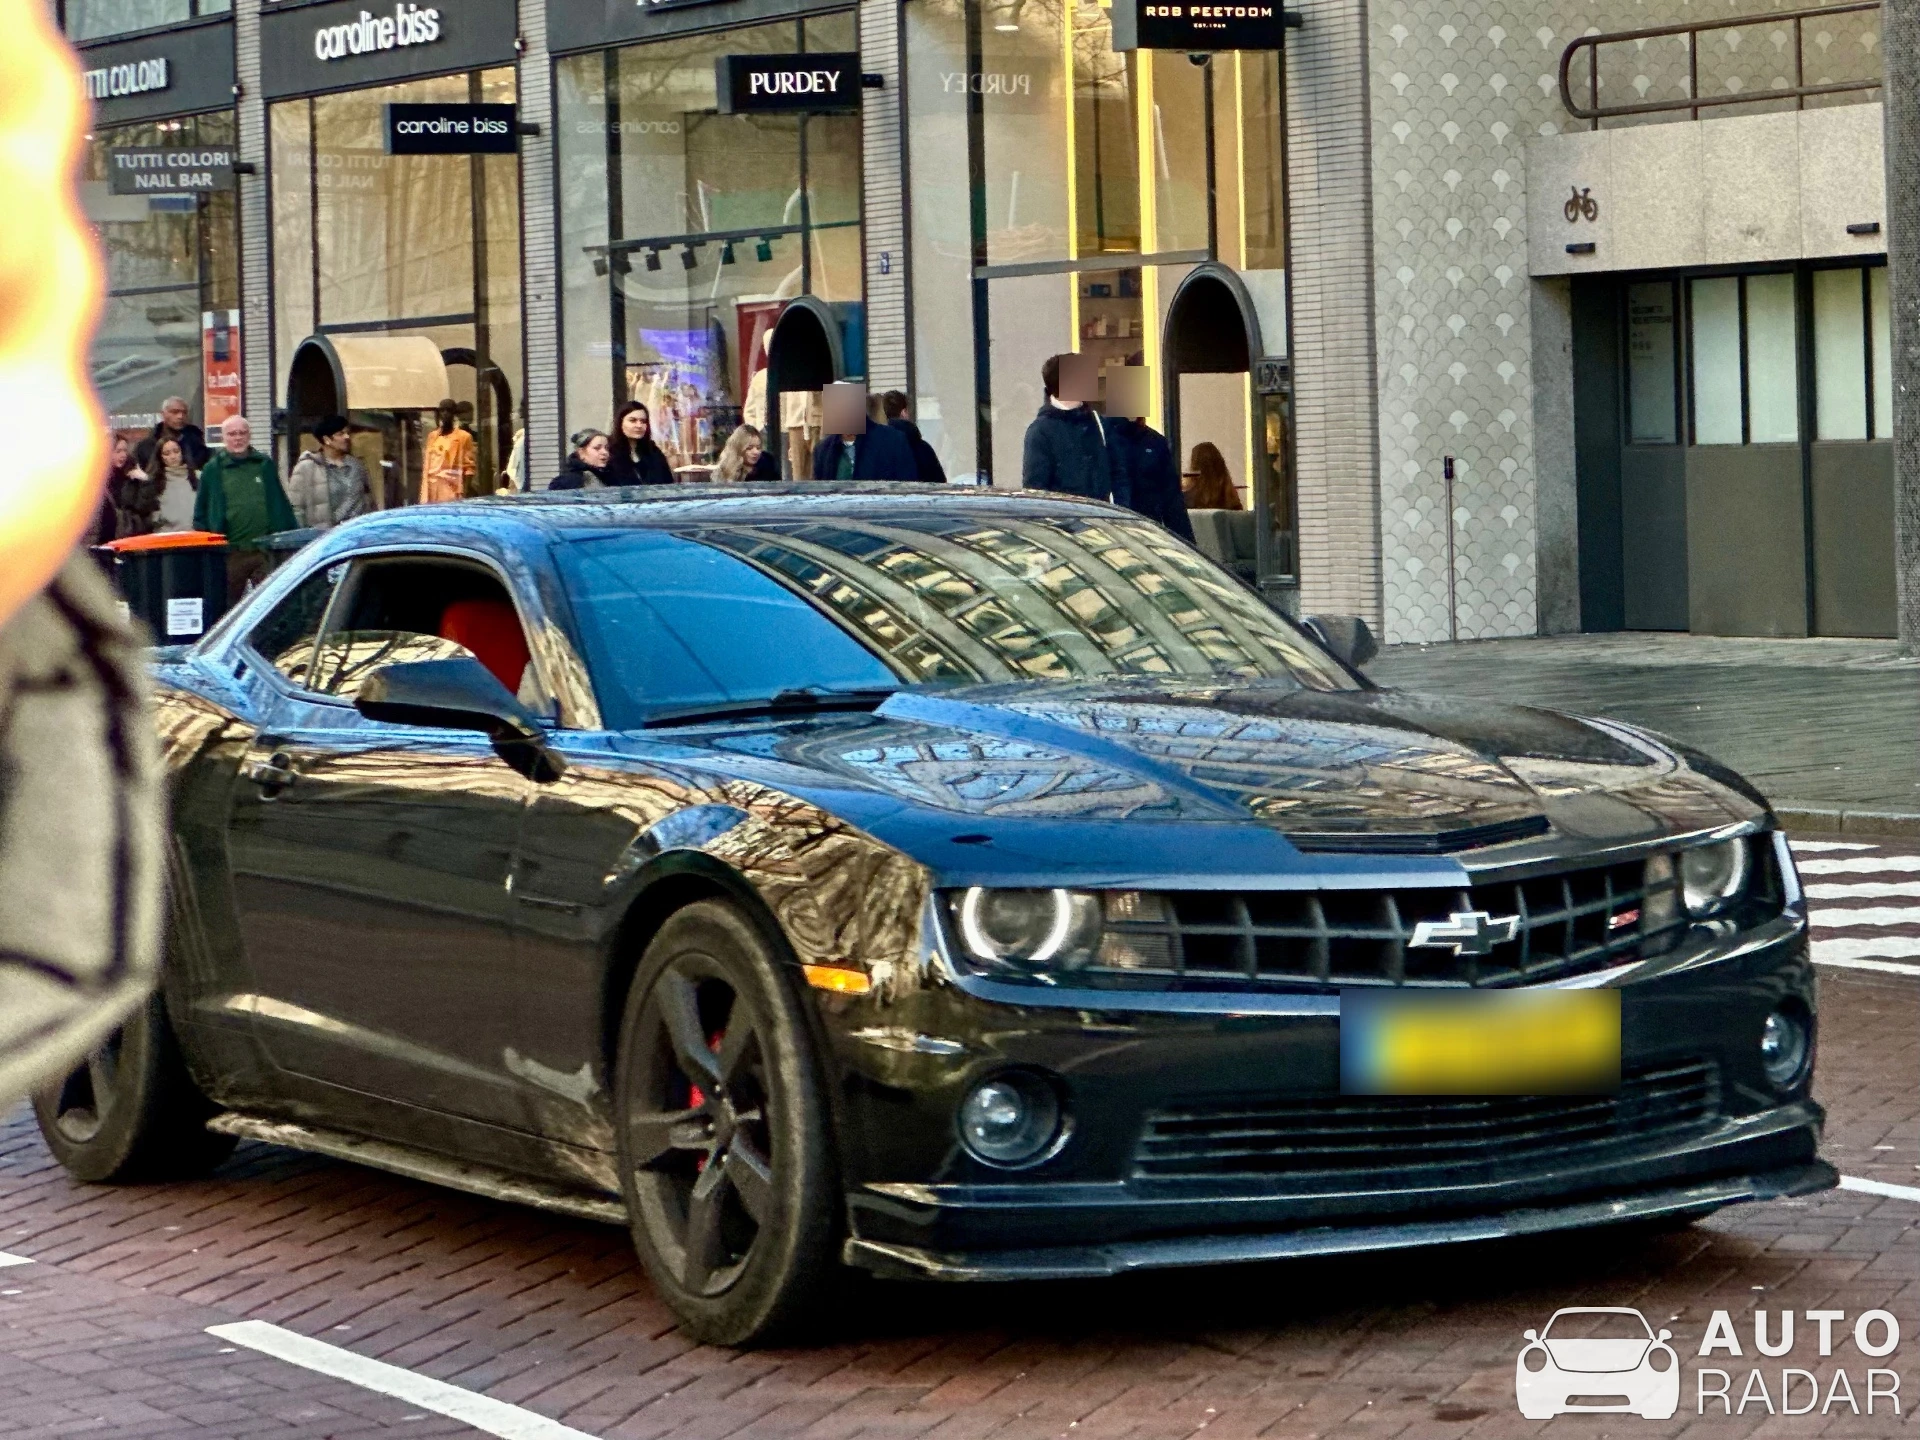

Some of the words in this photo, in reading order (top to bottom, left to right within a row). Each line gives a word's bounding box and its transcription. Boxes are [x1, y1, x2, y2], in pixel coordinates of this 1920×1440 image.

[1146, 6, 1182, 17] ROB
[1190, 6, 1272, 17] PEETOOM
[315, 10, 395, 60] caroline
[396, 3, 440, 46] biss
[110, 57, 167, 96] COLORI
[750, 71, 840, 94] PURDEY
[396, 117, 469, 134] caroline
[473, 117, 508, 133] biss
[114, 153, 163, 169] TUTTI
[167, 151, 229, 167] COLORI
[135, 173, 175, 189] NAIL
[179, 172, 213, 187] BAR
